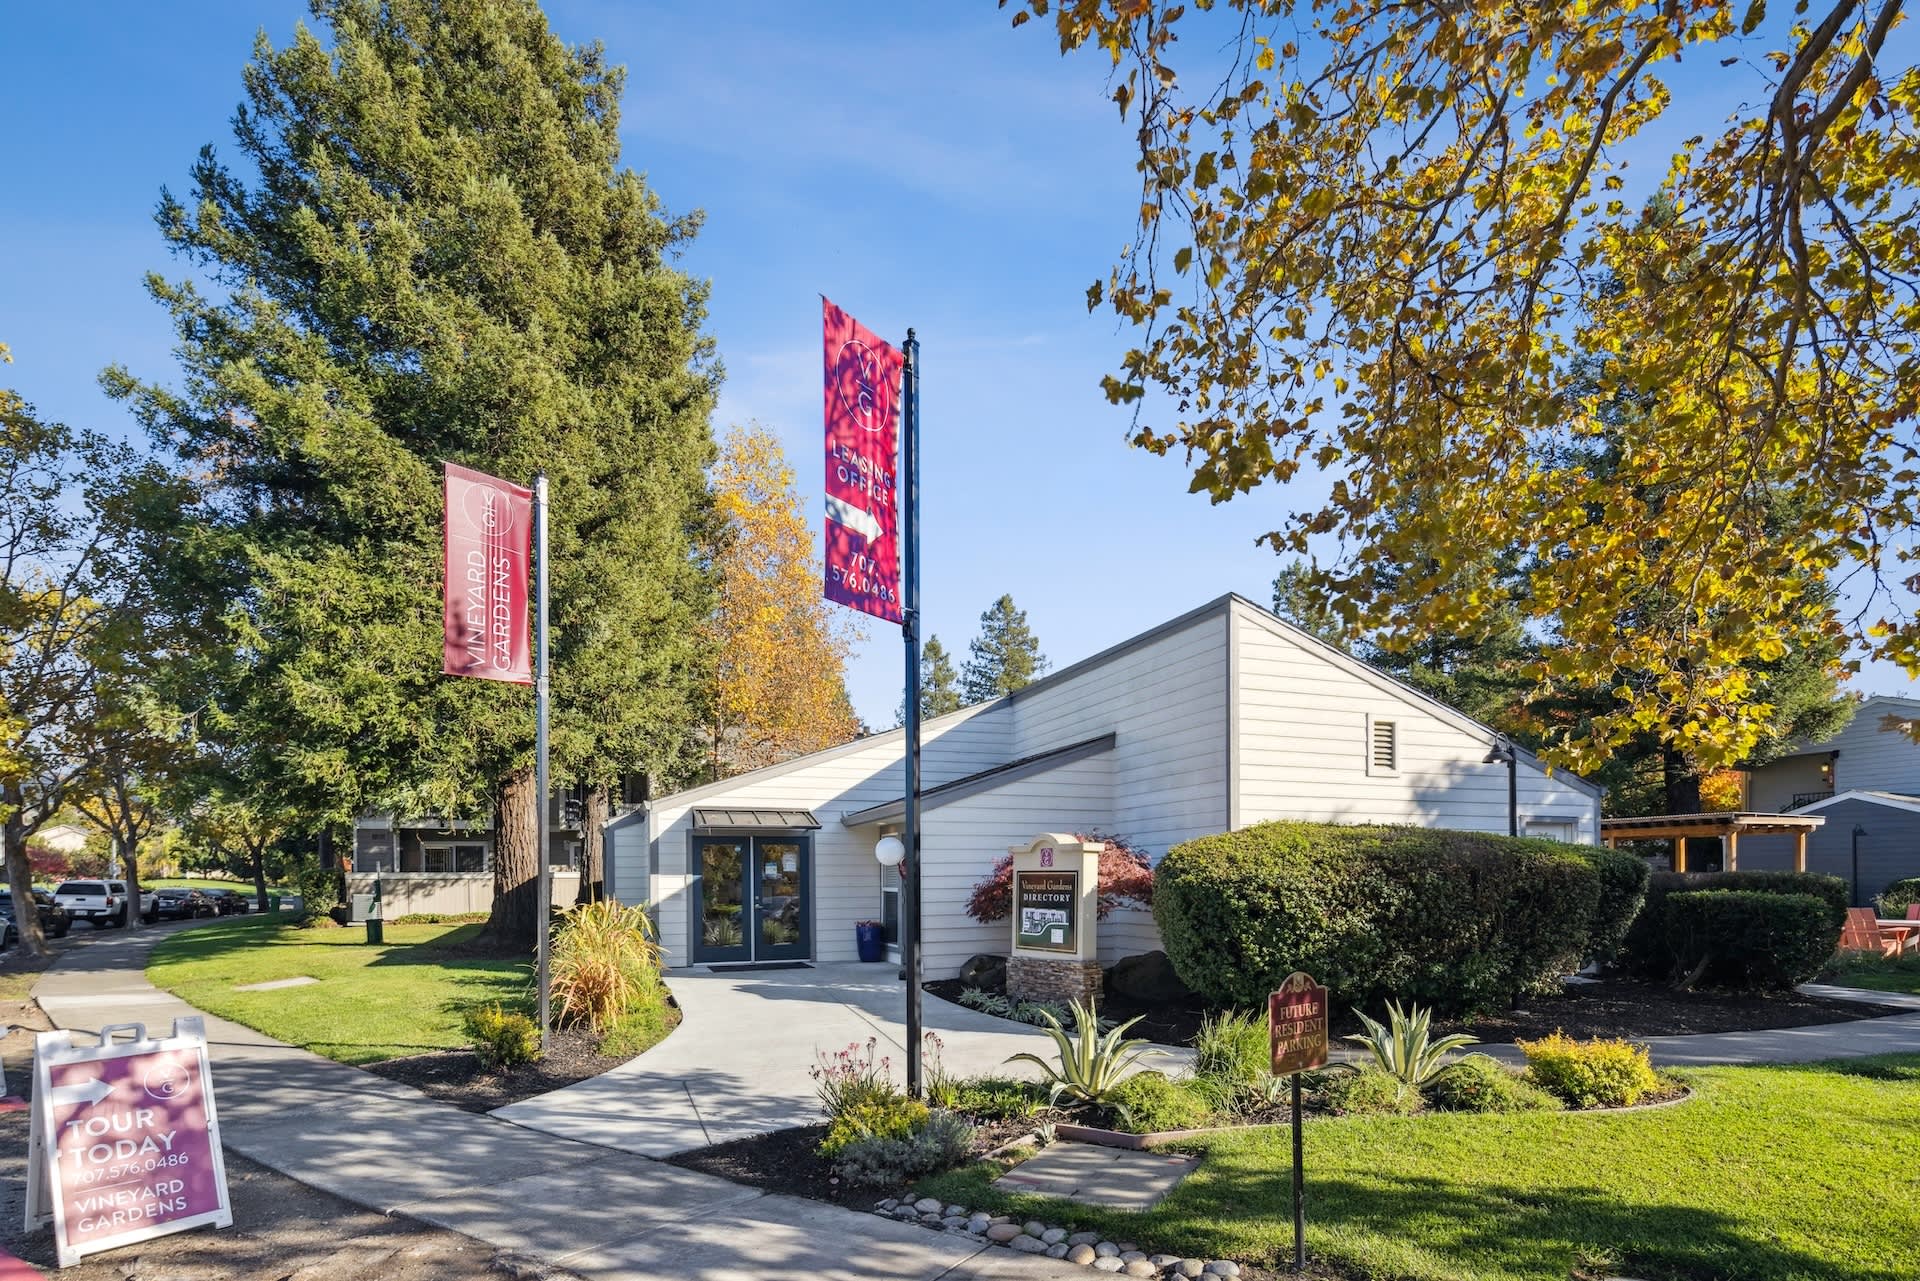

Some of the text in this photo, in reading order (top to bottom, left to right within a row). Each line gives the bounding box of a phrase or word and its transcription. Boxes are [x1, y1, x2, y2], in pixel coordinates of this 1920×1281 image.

[832, 439, 891, 488] LEASING
[837, 466, 889, 506] OFFICE
[851, 552, 879, 577] 707.
[832, 565, 896, 603] 576.0486
[467, 550, 486, 668] VINEYARD
[493, 557, 511, 672] GARDENS
[1022, 880, 1072, 892] Vineyard Gardens
[1023, 893, 1071, 902] DIRECTORY
[1275, 1018, 1323, 1038] RESIDENT
[1280, 1002, 1319, 1020] FUTURE
[1278, 1034, 1320, 1055] PARKING
[66, 1108, 155, 1142] TOUR
[70, 1130, 177, 1169] TODAY
[72, 1152, 189, 1184] 707.576.0486
[75, 1179, 184, 1213] VINEYARD
[78, 1196, 188, 1233] GARDENS
